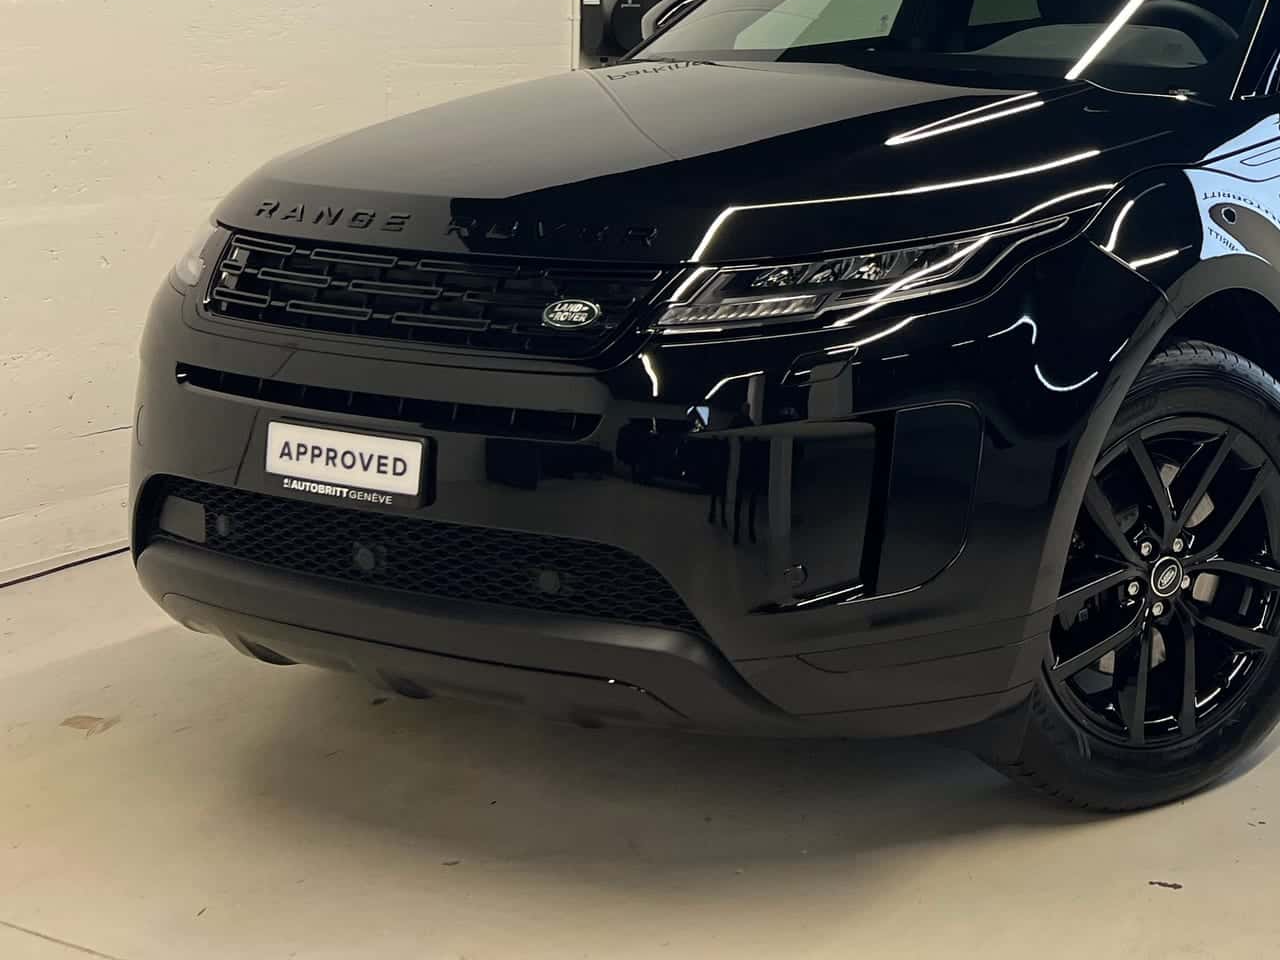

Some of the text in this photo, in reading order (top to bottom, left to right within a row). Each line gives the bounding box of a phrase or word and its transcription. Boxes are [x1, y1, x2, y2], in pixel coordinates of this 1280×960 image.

[255, 200, 413, 233] RANGE
[552, 311, 588, 322] ROVER
[553, 303, 584, 312] LAND
[279, 440, 408, 477] APPROVED
